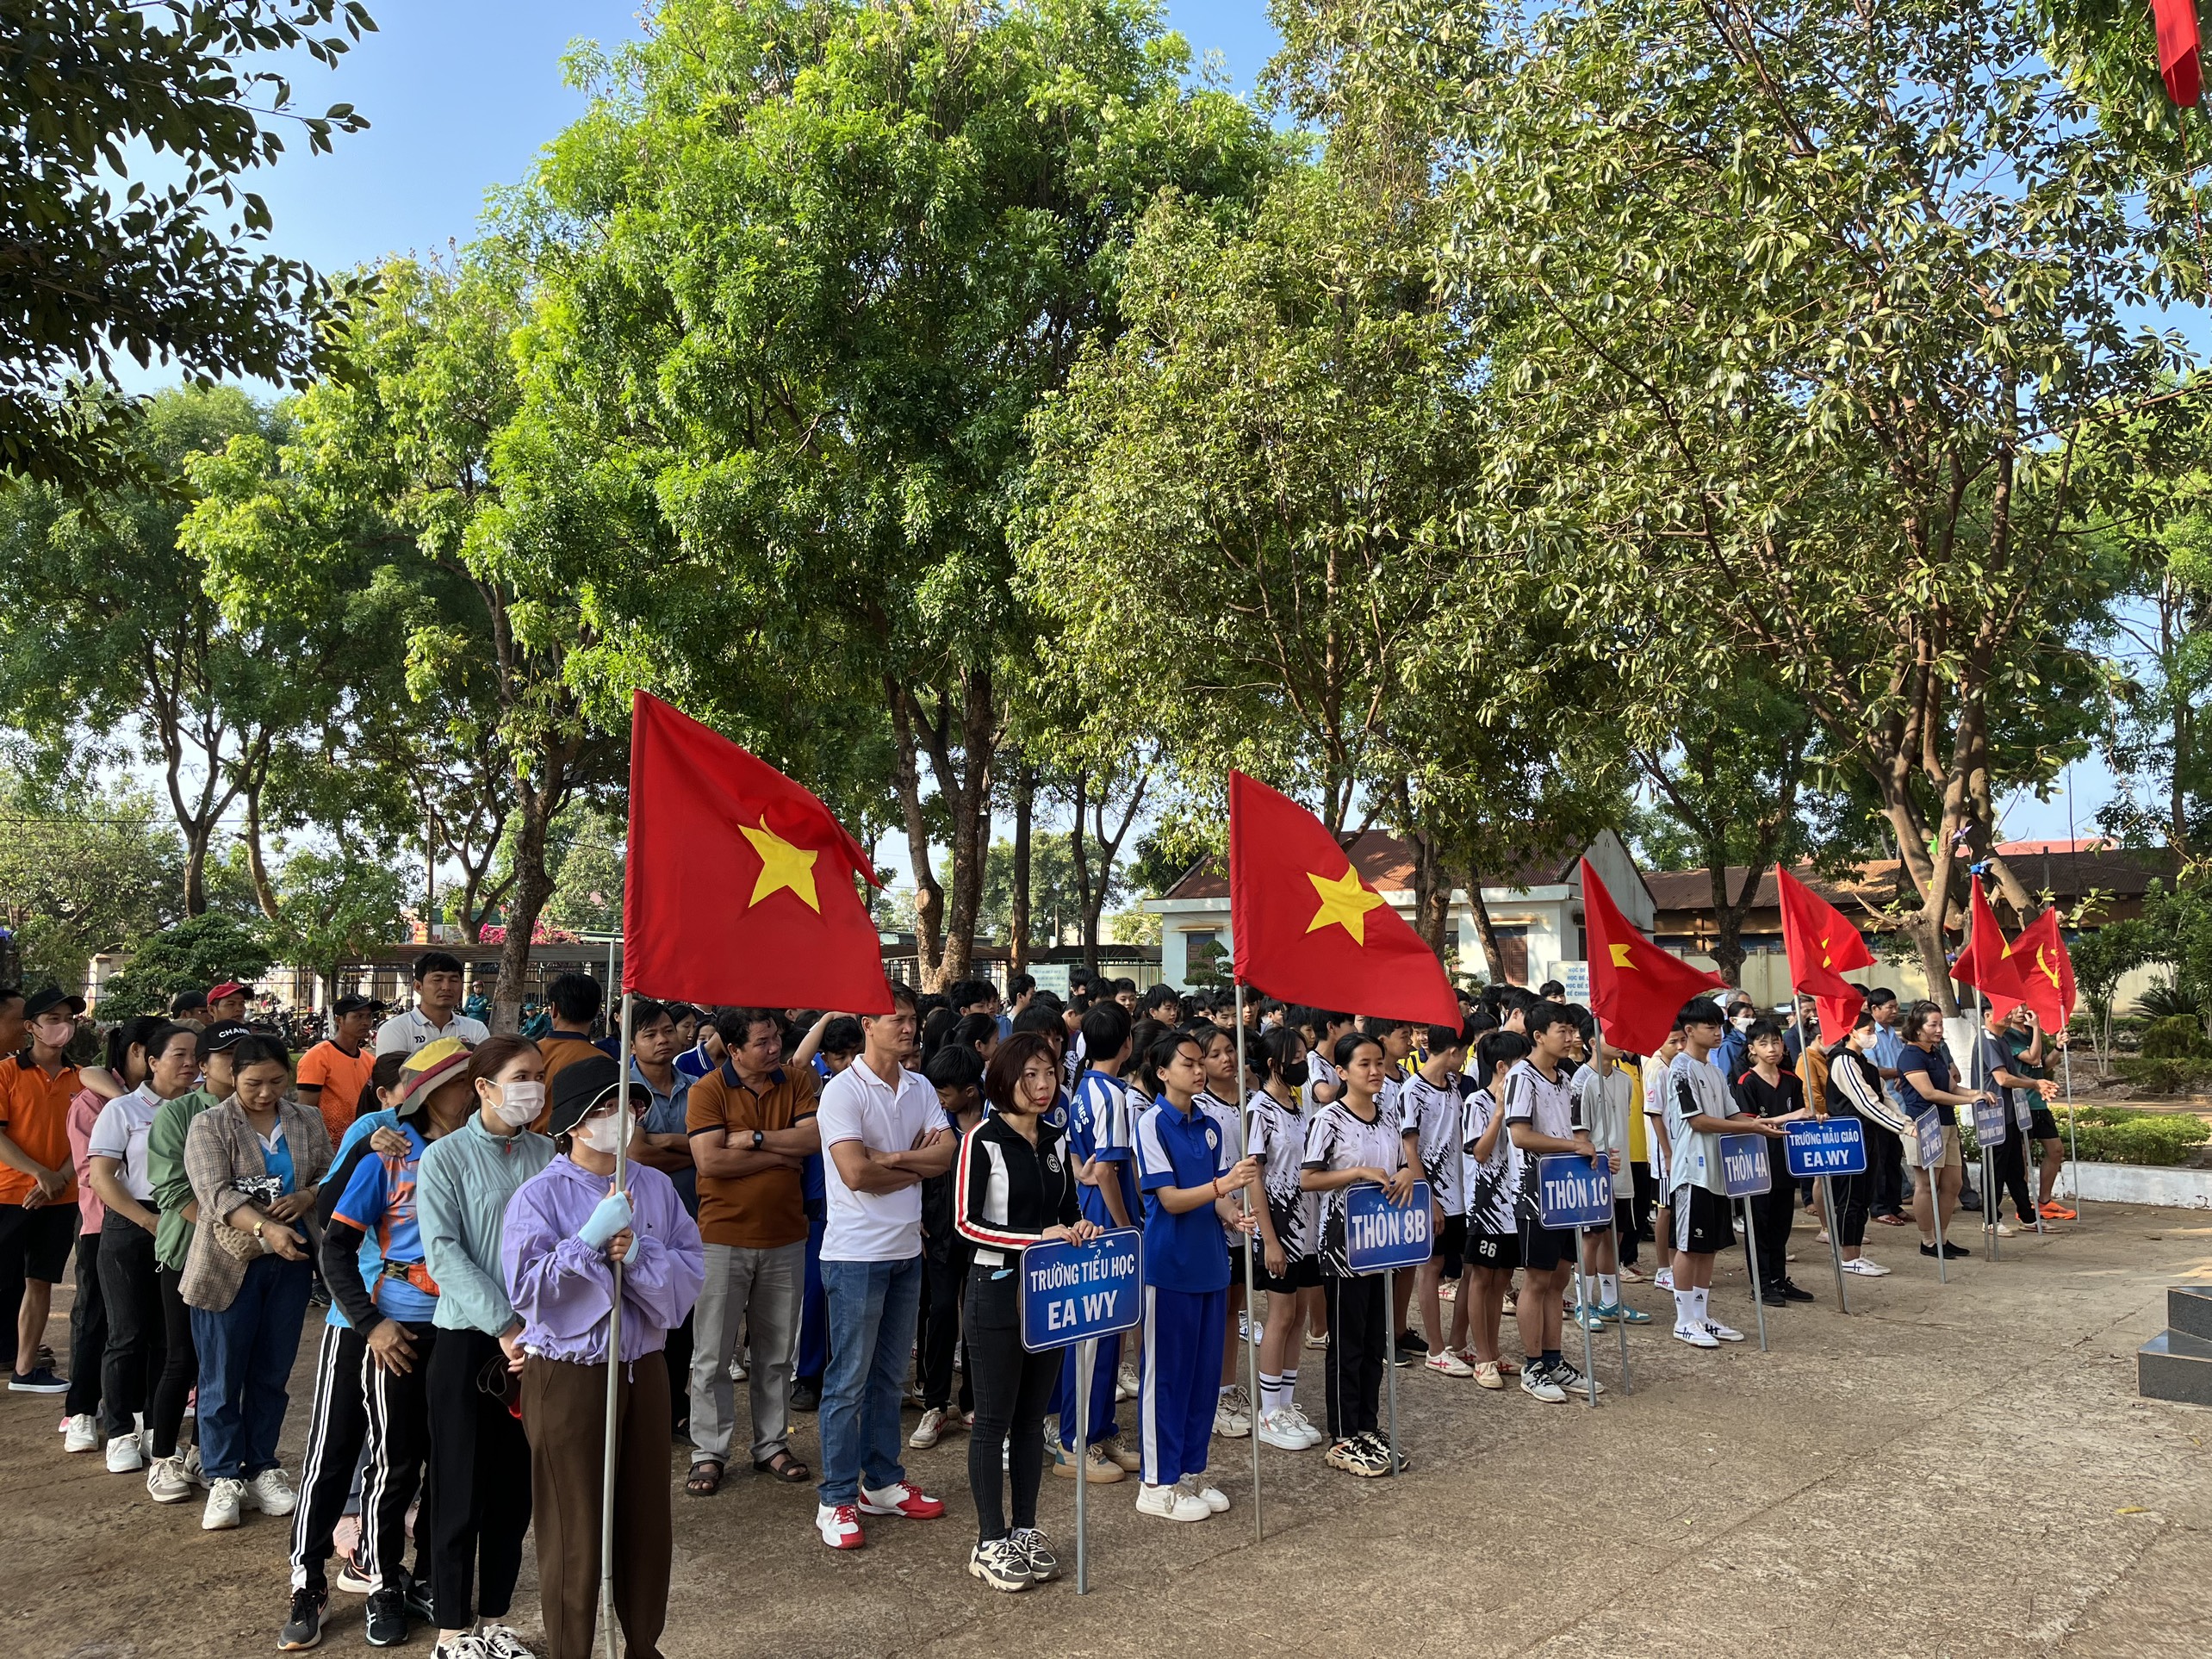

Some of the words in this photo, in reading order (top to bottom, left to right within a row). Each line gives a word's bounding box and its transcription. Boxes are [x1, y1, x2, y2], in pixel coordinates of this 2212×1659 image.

[1789, 1130, 1822, 1146] TRƯỜNG
[1822, 1127, 1840, 1144] MẪU
[1841, 1128, 1859, 1143] GIÁO
[1724, 1147, 1754, 1183] THÔN
[1755, 1152, 1768, 1178] 4A
[1803, 1151, 1824, 1167] EA
[1825, 1149, 1849, 1165] WY
[1544, 1171, 1588, 1210] THÔN
[1591, 1176, 1608, 1207] 1C
[1351, 1203, 1400, 1250] THÔN
[1404, 1209, 1426, 1244] 8B
[1030, 1260, 1079, 1293] TRƯỜNG
[1081, 1249, 1109, 1283] TIỂU
[1111, 1253, 1135, 1280] HỌC
[1047, 1298, 1078, 1331] EA
[1083, 1289, 1118, 1323] WY
